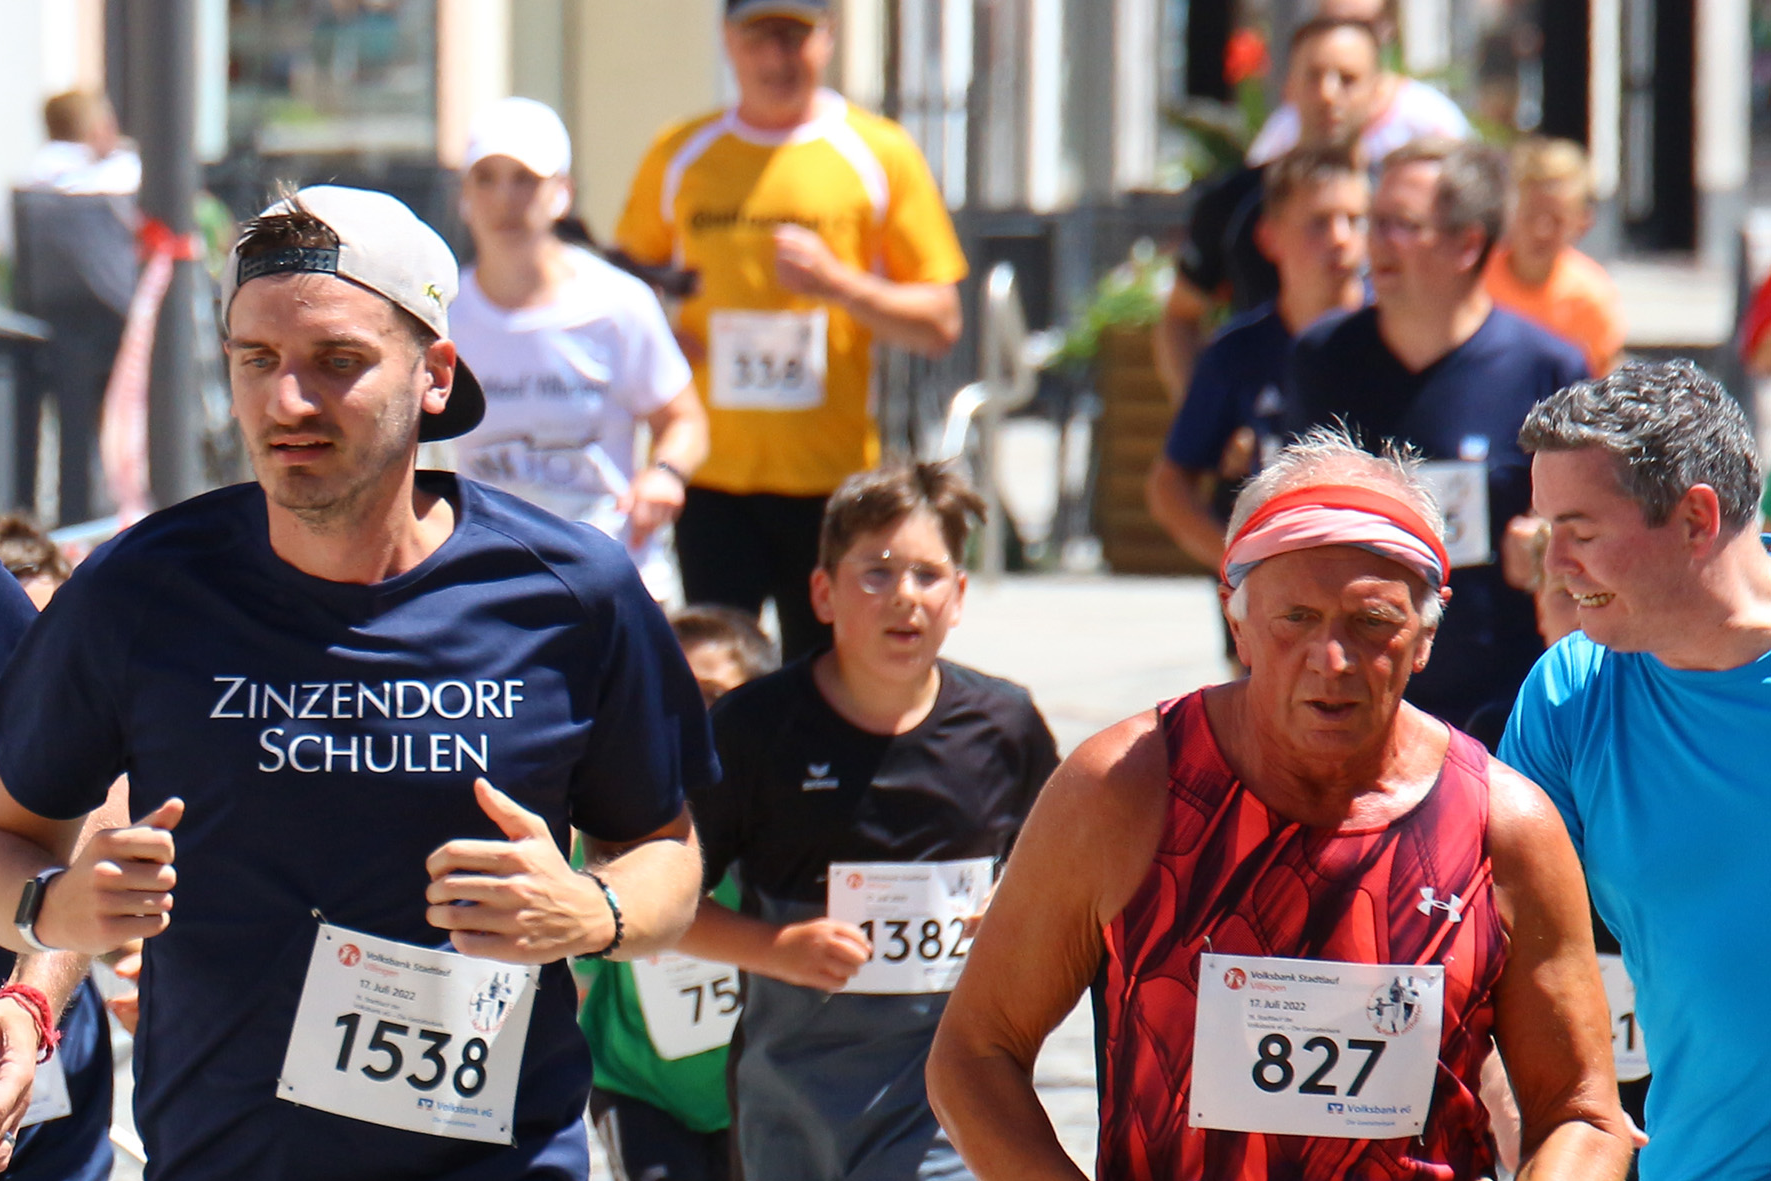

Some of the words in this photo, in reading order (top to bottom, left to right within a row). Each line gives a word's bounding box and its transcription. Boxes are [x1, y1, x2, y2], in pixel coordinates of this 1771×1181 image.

[209, 676, 524, 719] ZINZENDORF
[258, 727, 488, 772] SCHULEN
[860, 917, 966, 961] 1382
[392, 988, 416, 1001] 2022
[1251, 970, 1296, 981] Volksbank
[1298, 974, 1340, 985] Stadtlauf
[1264, 1000, 1280, 1009] Juli
[1283, 1001, 1306, 1011] 2022
[335, 1013, 488, 1098] 1538
[1251, 1033, 1386, 1097] 827
[1347, 1104, 1397, 1114] Volksbank
